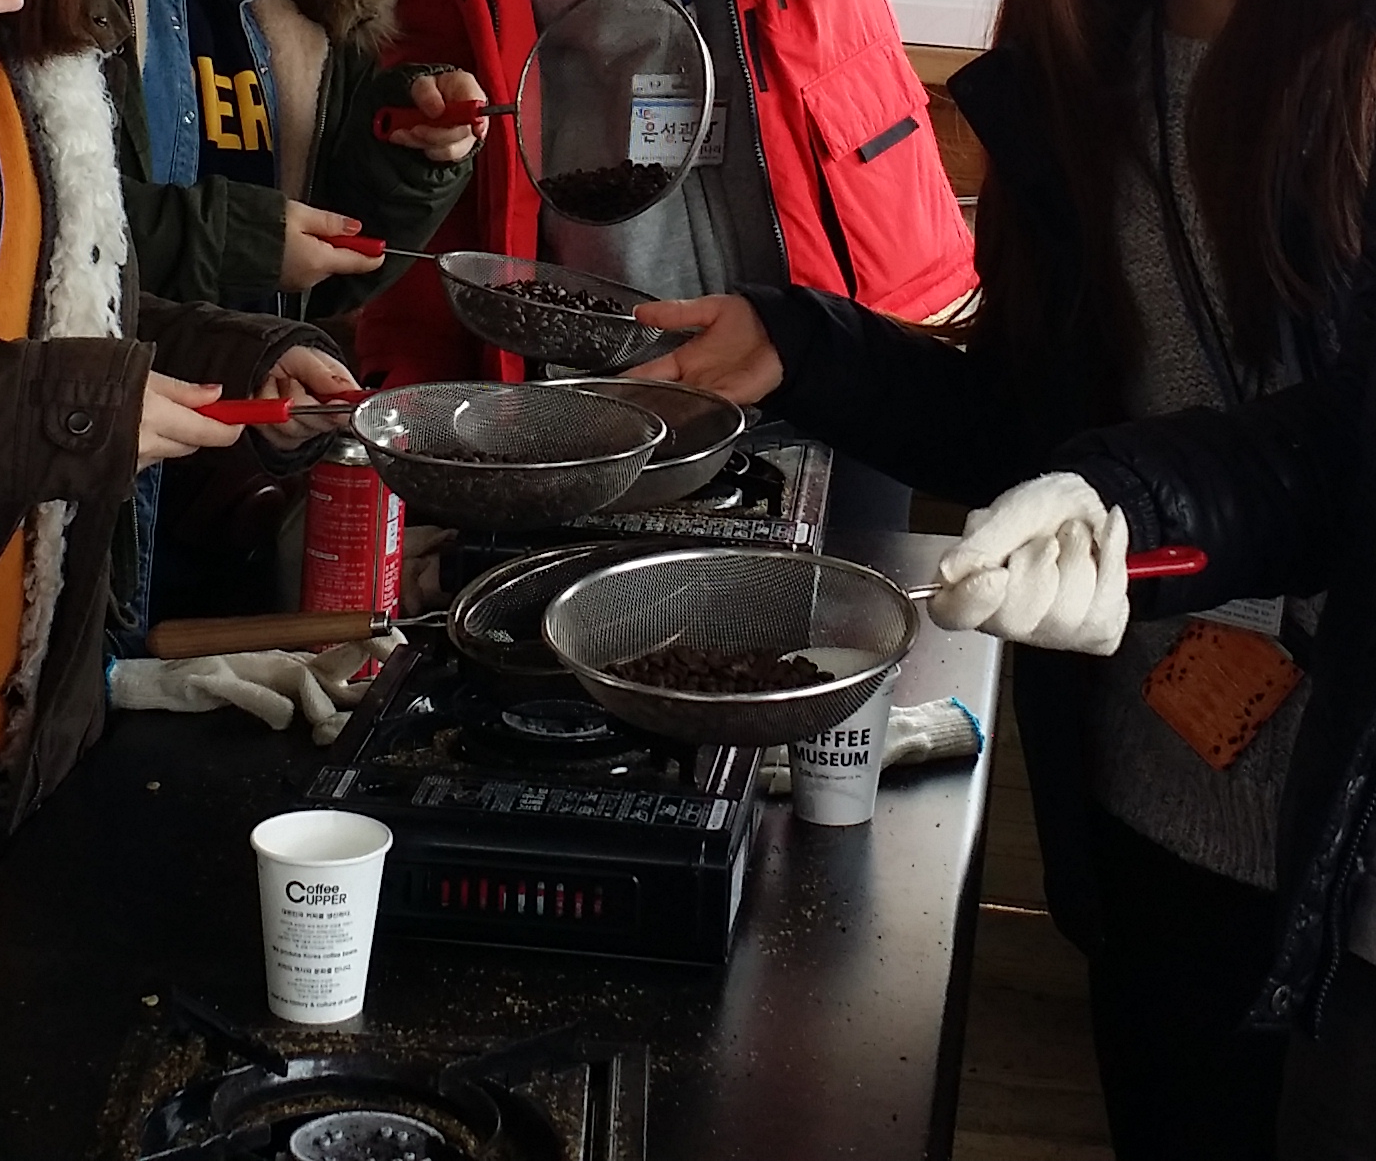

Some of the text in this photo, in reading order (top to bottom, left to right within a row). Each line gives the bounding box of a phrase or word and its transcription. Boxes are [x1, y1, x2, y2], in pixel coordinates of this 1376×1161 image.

[800, 728, 871, 749] OFFEE
[793, 744, 870, 767] MUSEUM
[285, 880, 340, 904] Coffee
